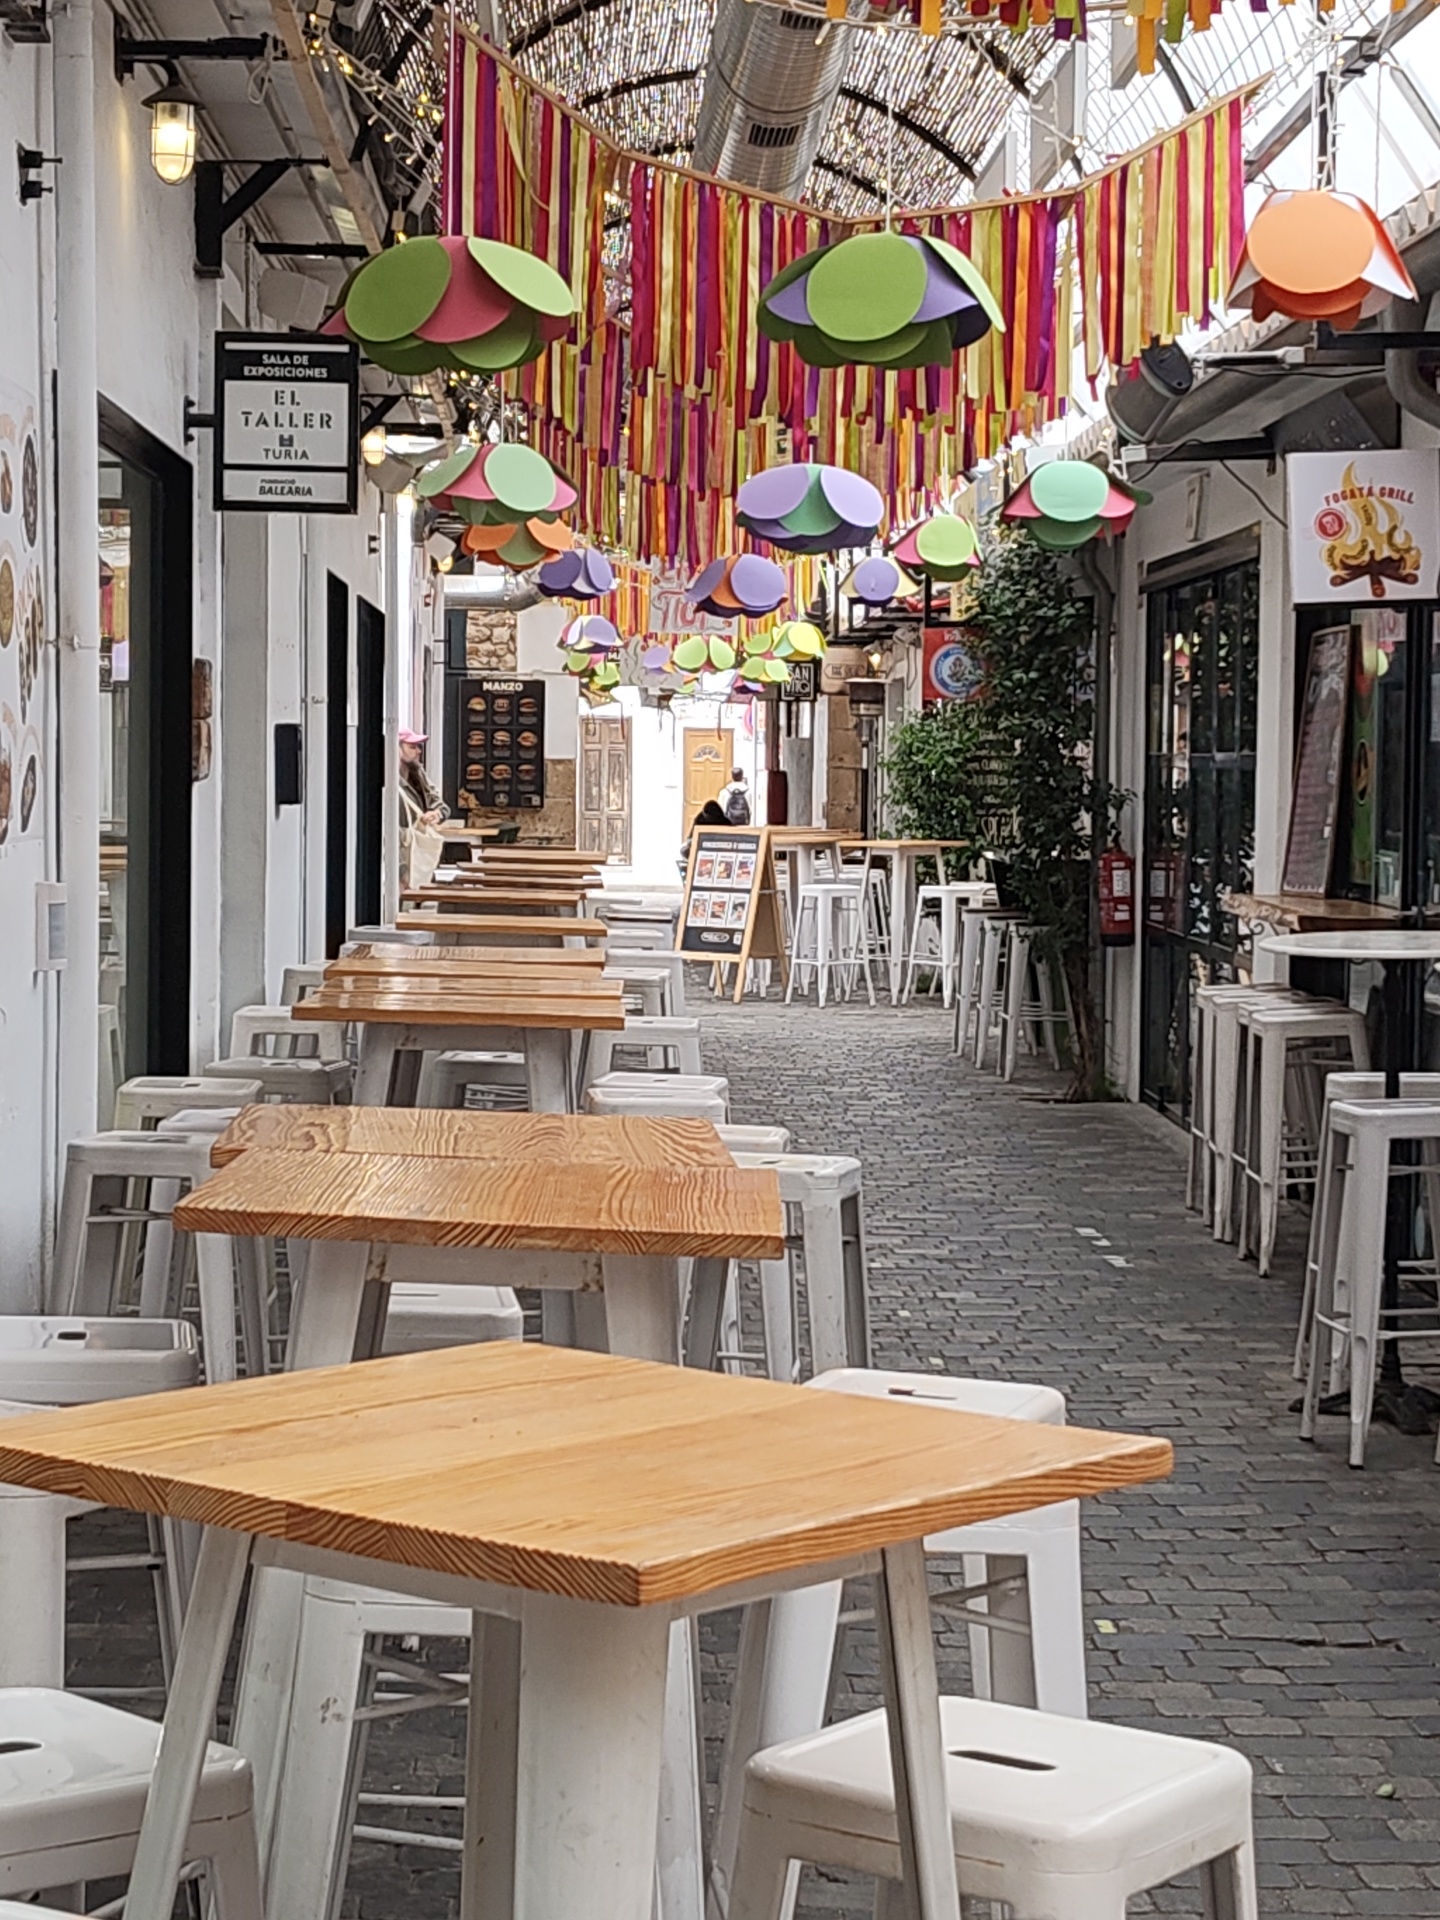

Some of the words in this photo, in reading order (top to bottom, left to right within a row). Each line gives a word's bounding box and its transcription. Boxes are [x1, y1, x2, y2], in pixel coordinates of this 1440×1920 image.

[262, 354, 291, 365] SALA
[293, 355, 309, 365] DE
[243, 366, 328, 378] EXPOSICIONES
[274, 390, 300, 405] EL
[241, 412, 332, 428] TALLER
[263, 448, 310, 460] TURIA
[1324, 486, 1375, 506] FOGATA
[1379, 486, 1415, 504] GRILL
[483, 681, 523, 691] MANZO
